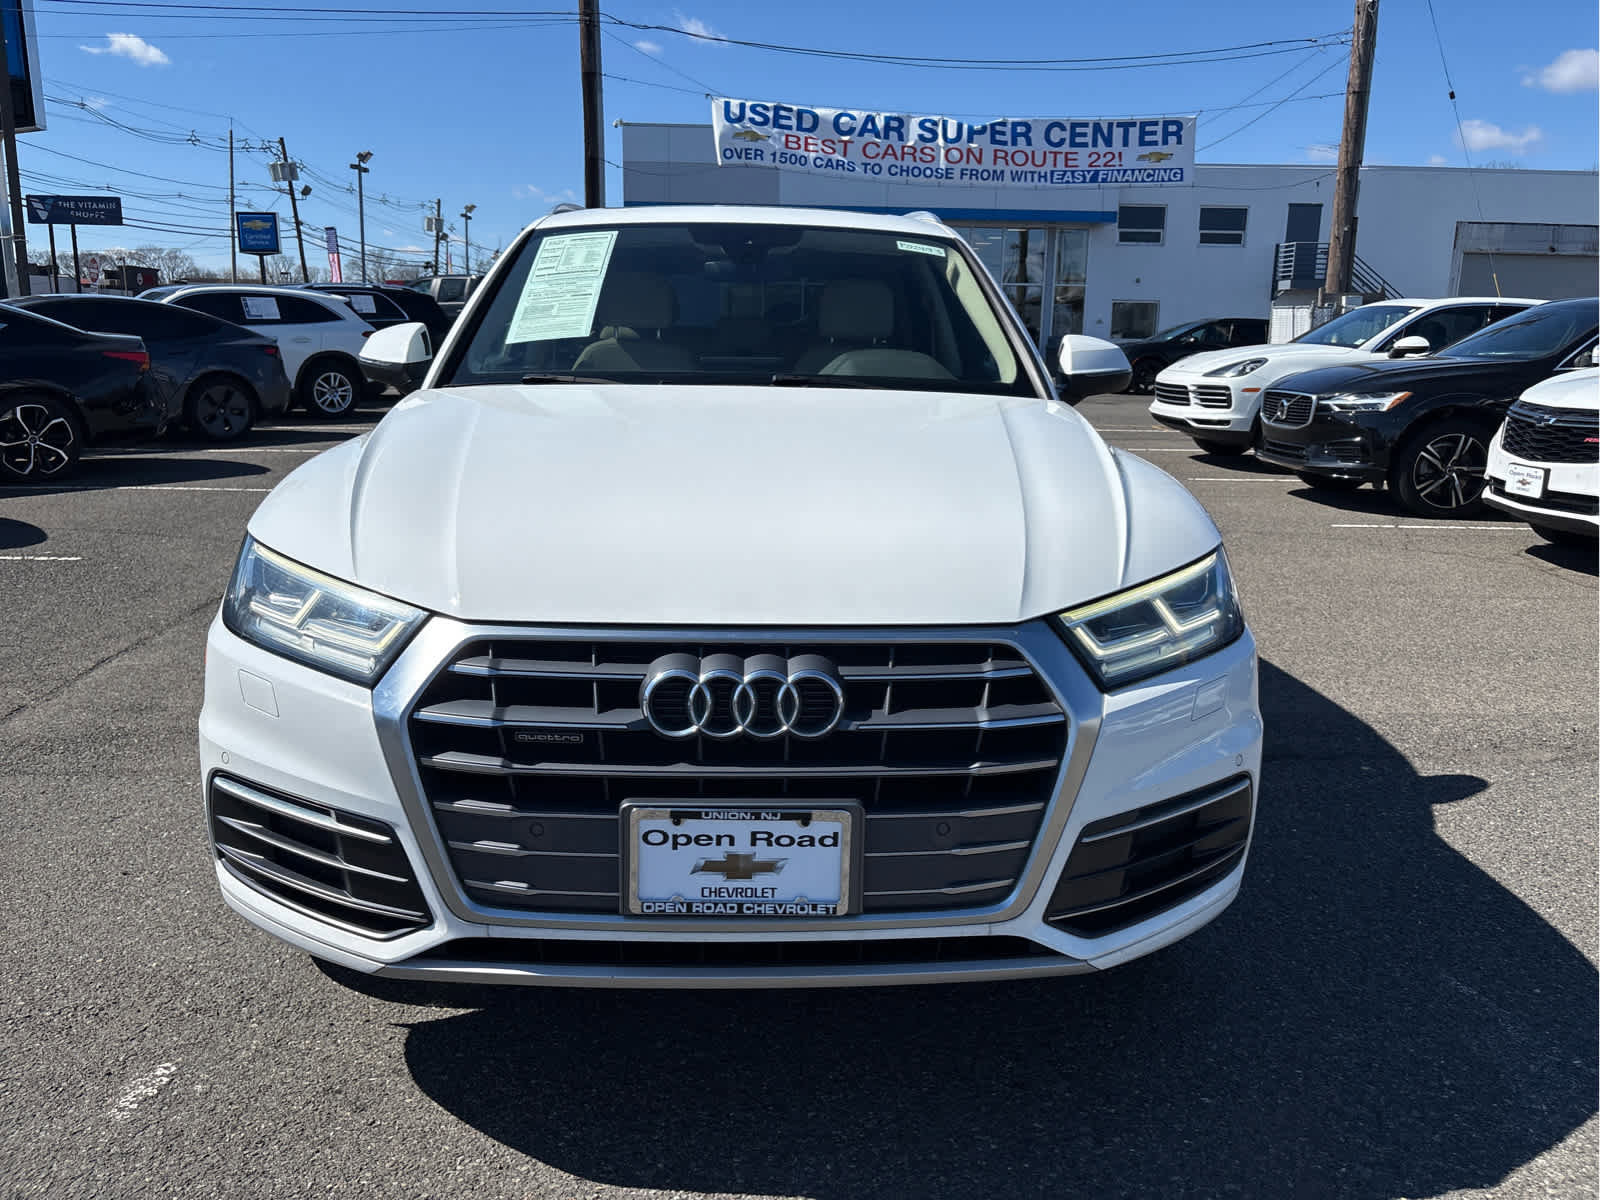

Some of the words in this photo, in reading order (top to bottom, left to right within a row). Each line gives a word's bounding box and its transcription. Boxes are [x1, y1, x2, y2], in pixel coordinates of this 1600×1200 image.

[723, 101, 820, 133] USED
[832, 112, 905, 142] CAR
[918, 118, 1033, 147] SUPER
[1044, 120, 1184, 148] CENTER
[784, 134, 854, 158] BEST
[862, 144, 936, 164] CARS
[944, 147, 983, 166] ON
[992, 148, 1079, 169] ROUTE
[1087, 151, 1123, 169] 22!
[722, 147, 764, 162] OVER
[770, 152, 808, 167] 1500
[813, 156, 857, 173] CARS
[861, 162, 882, 176] TO
[888, 164, 955, 180] CHOOSE
[960, 168, 1004, 183] FROM
[1010, 169, 1048, 184] WITH
[1052, 169, 1098, 184] EASY
[1098, 168, 1182, 183] FINANCING
[57, 201, 75, 209] THE
[77, 201, 116, 209] VITAMIN
[517, 733, 581, 743] quattro
[761, 812, 782, 821] NJ
[641, 829, 736, 851] Open
[750, 830, 840, 848] Road
[701, 886, 779, 899] CHEVROLET
[643, 902, 687, 914] OPEN
[692, 903, 738, 914] ROAD
[742, 903, 837, 915] CHEVROLET
